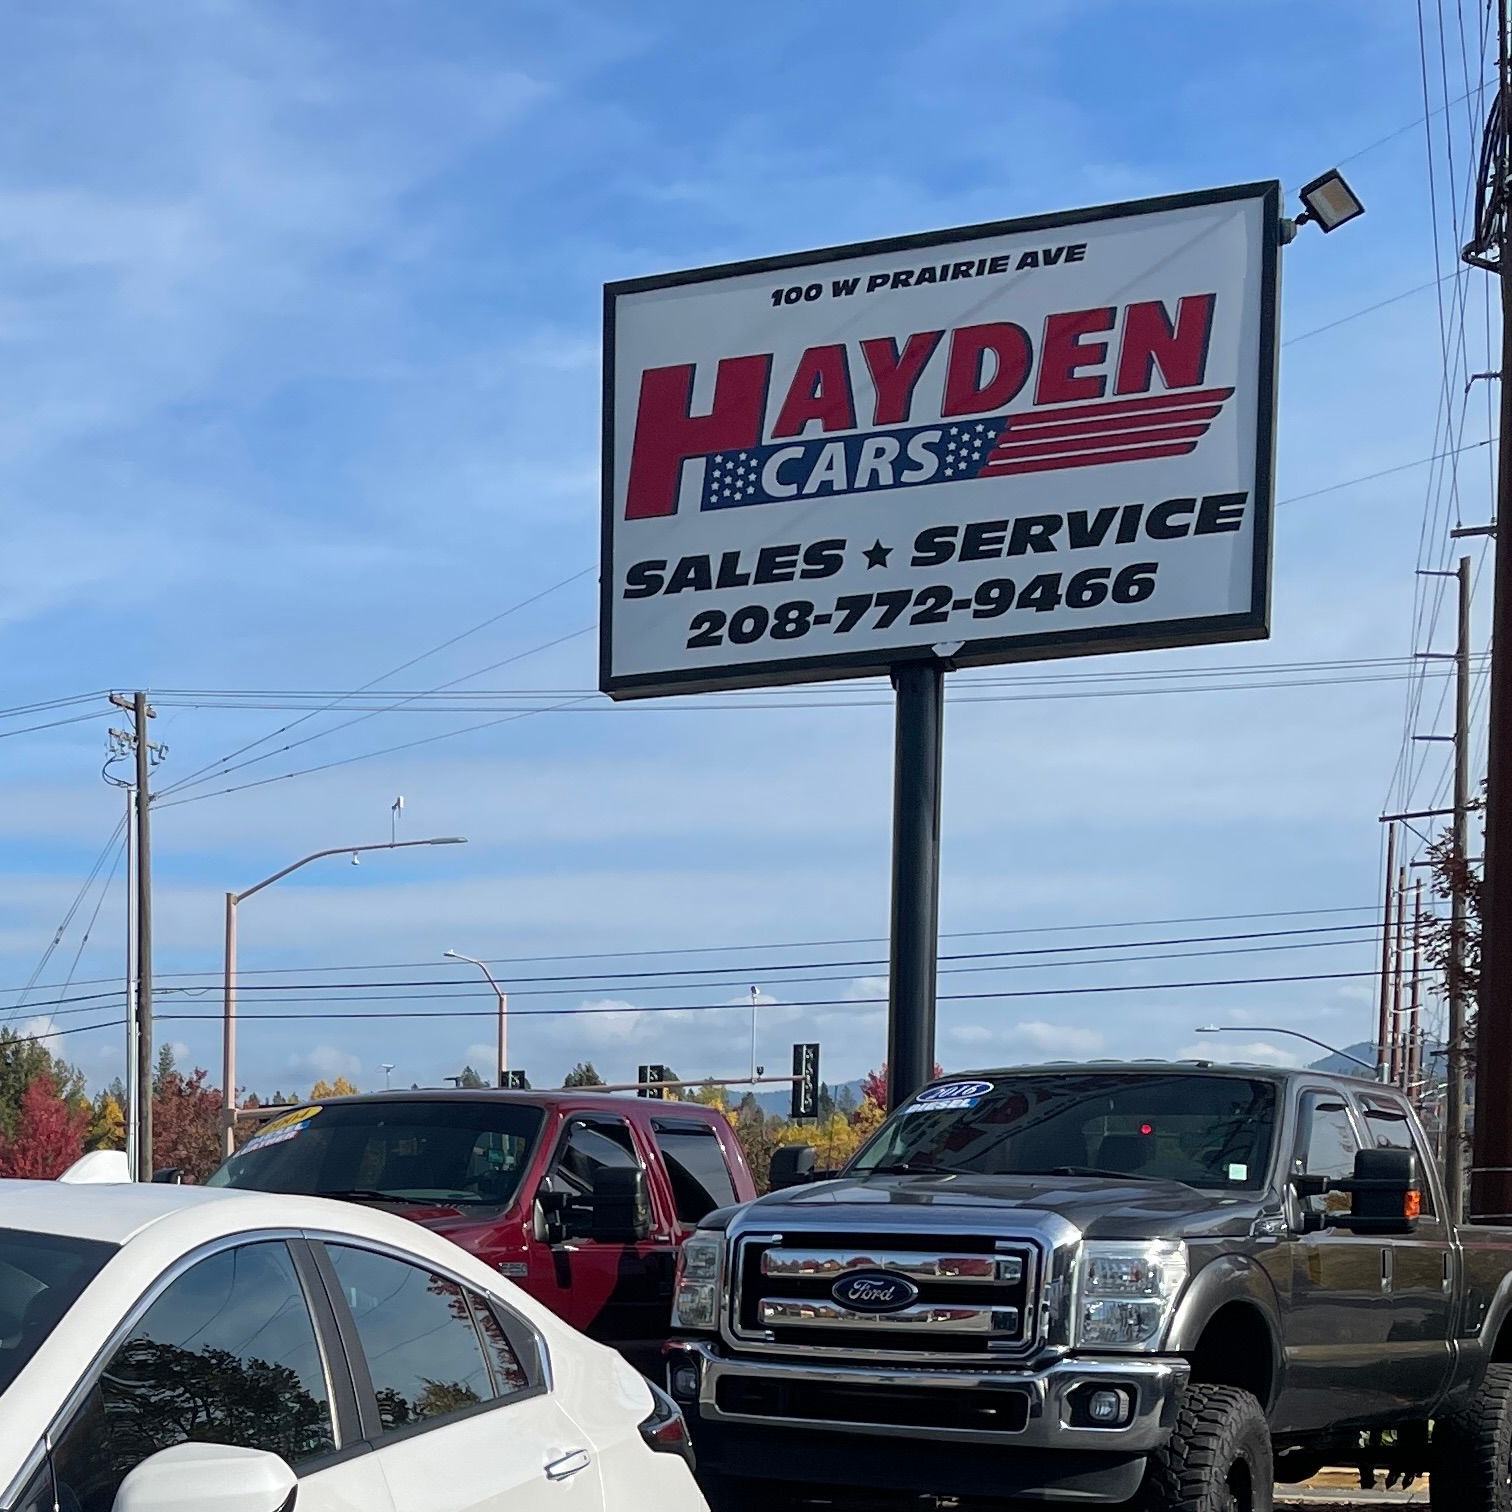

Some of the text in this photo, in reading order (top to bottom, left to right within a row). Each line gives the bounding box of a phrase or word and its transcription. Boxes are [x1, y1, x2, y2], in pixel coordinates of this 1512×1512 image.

[771, 243, 1088, 307] 100 W PRAIRIE AVE
[625, 293, 1216, 520] HAYDEN
[760, 429, 943, 499] CARS
[622, 491, 1248, 599] SALES SERVICE
[686, 562, 1158, 650] 208-772-9466
[848, 1280, 896, 1301] Ford
